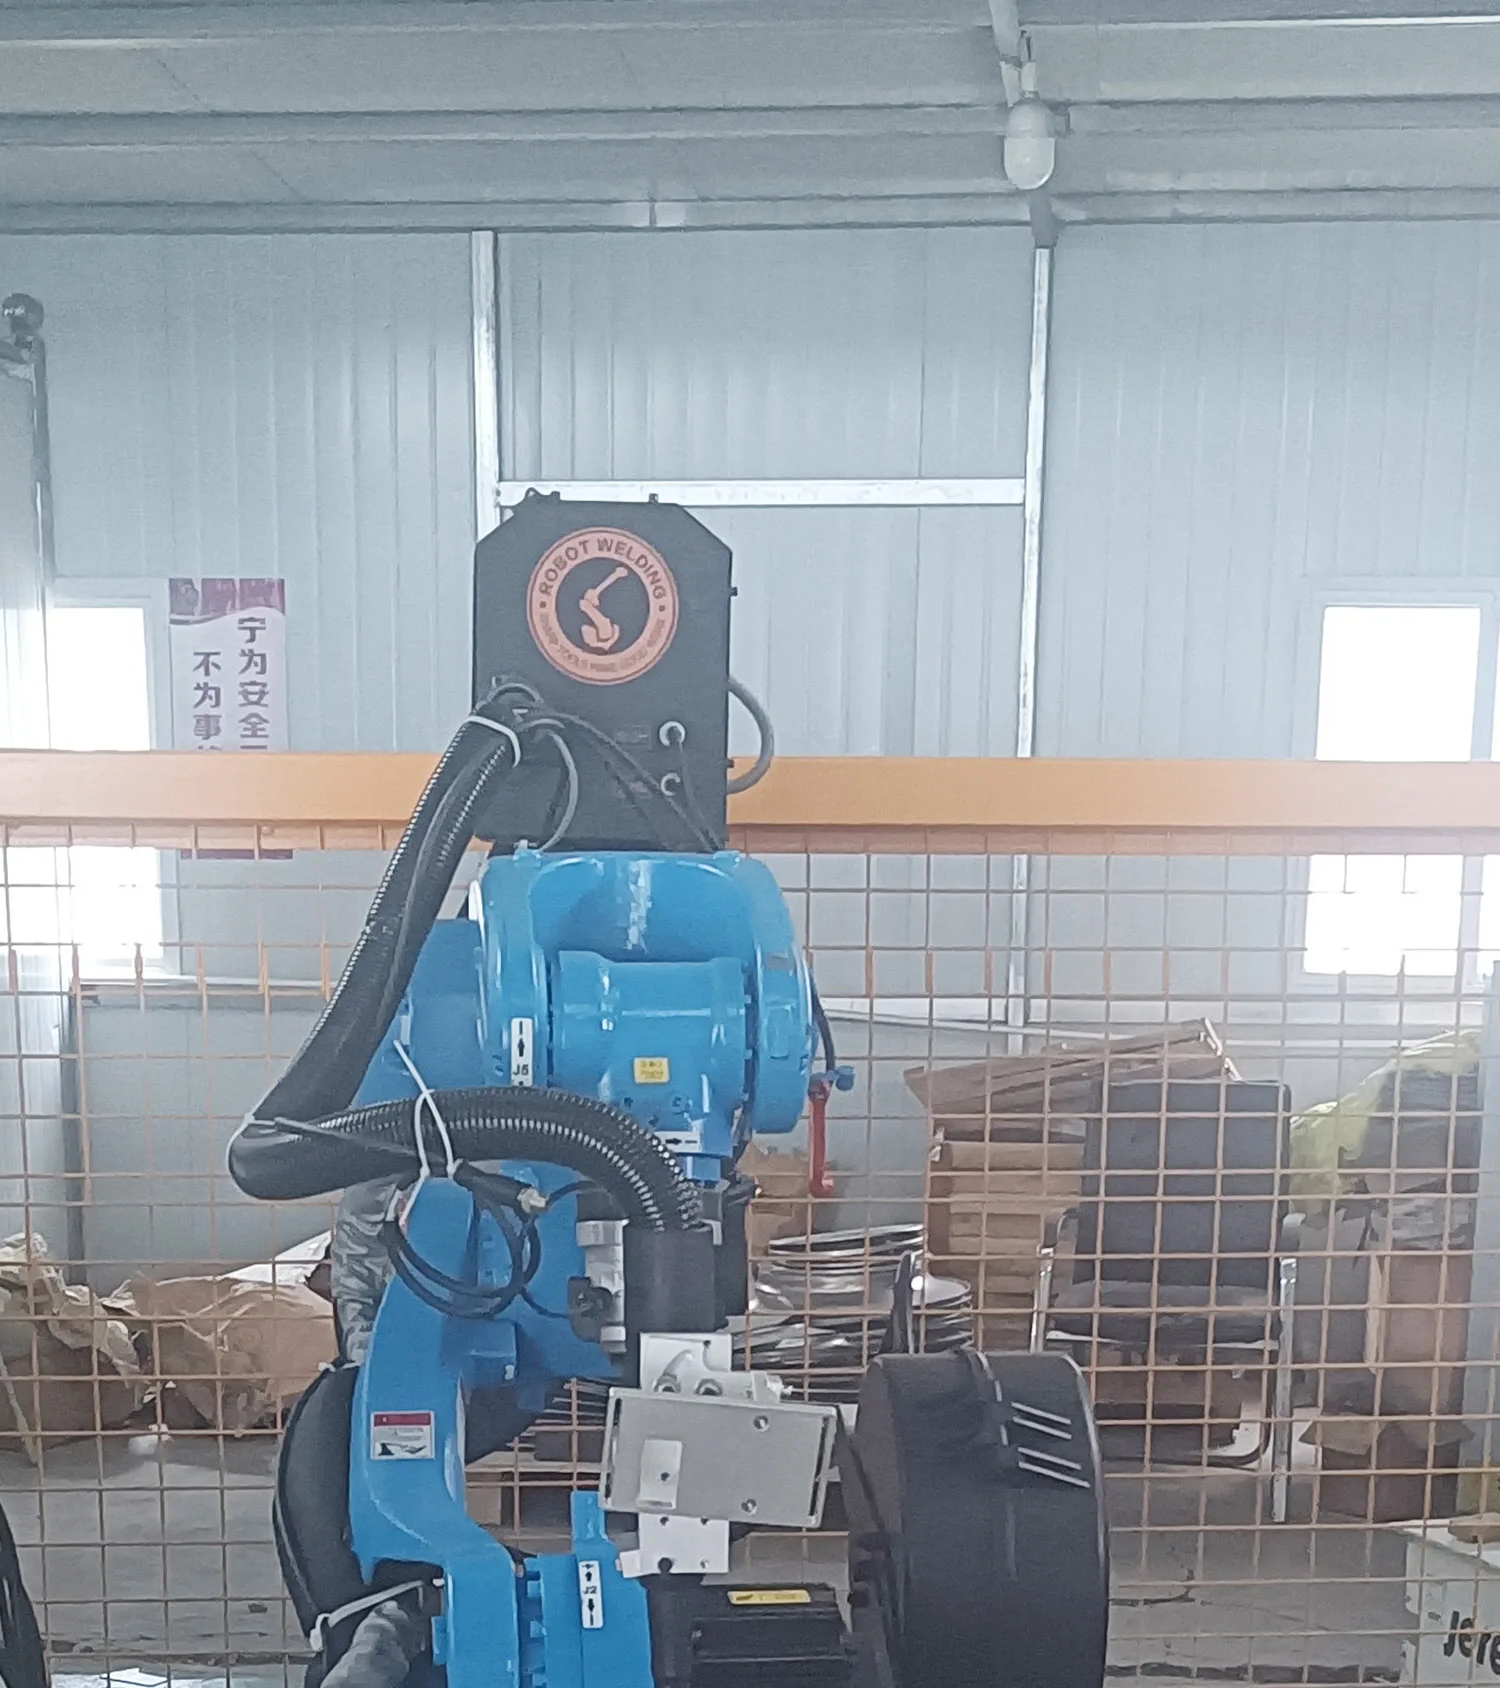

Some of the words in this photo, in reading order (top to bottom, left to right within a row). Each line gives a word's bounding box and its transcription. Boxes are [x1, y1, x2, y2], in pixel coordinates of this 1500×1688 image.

[538, 540, 590, 597] ROBOT
[597, 537, 667, 600] WELDING
[192, 651, 222, 750] 不为事
[237, 616, 270, 750] 宁为安全
[583, 1585, 598, 1595] J2
